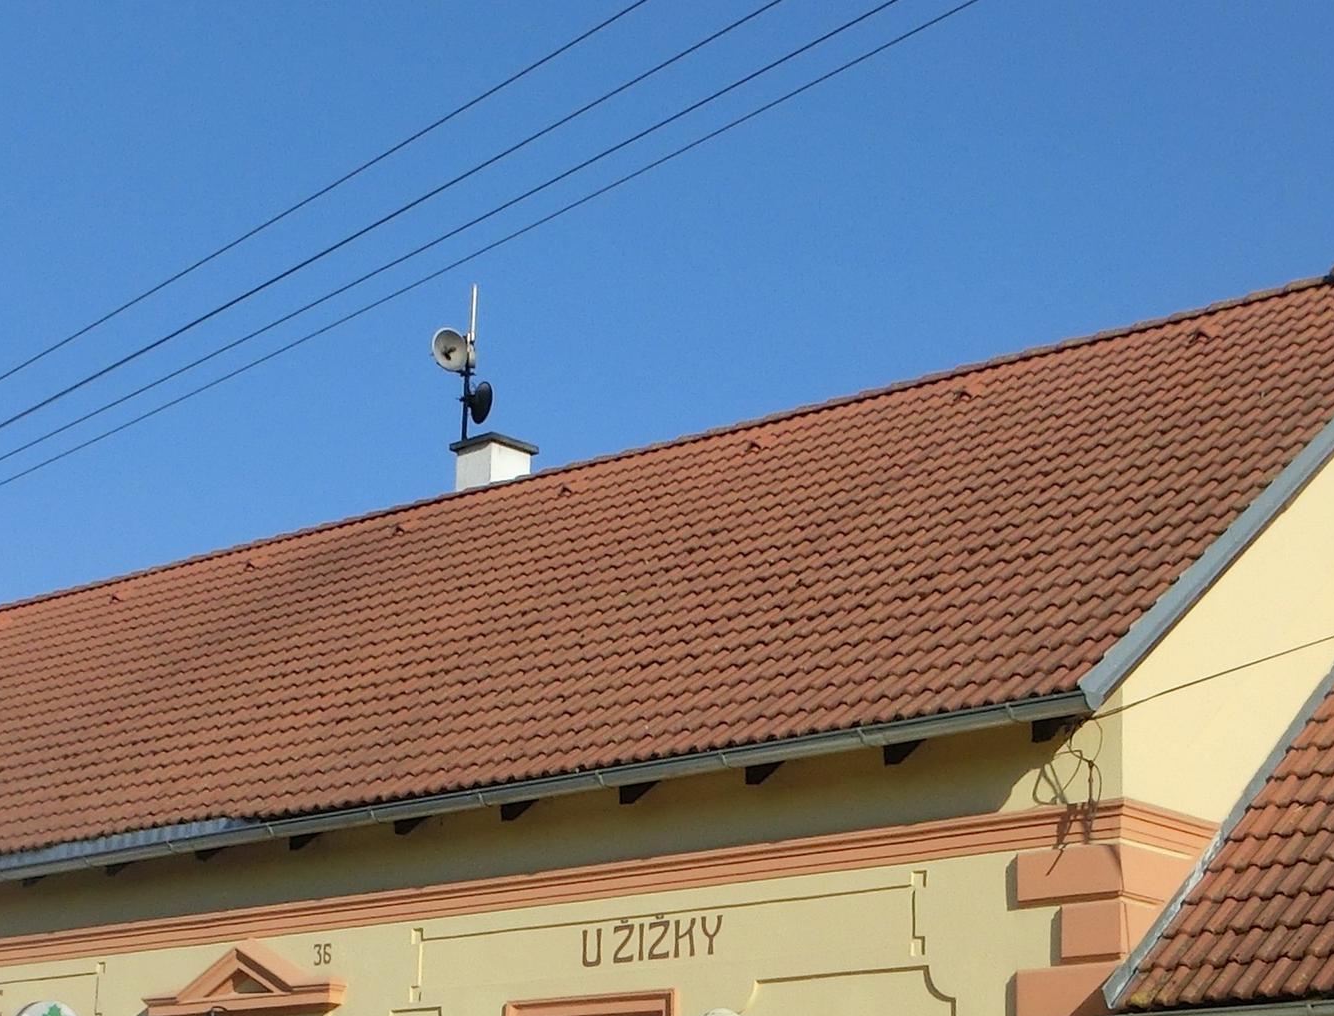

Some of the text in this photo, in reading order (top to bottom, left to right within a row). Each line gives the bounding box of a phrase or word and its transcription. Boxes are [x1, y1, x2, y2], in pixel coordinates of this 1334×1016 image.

[312, 943, 332, 966] 36
[581, 914, 724, 968] U ŽIŽKY
